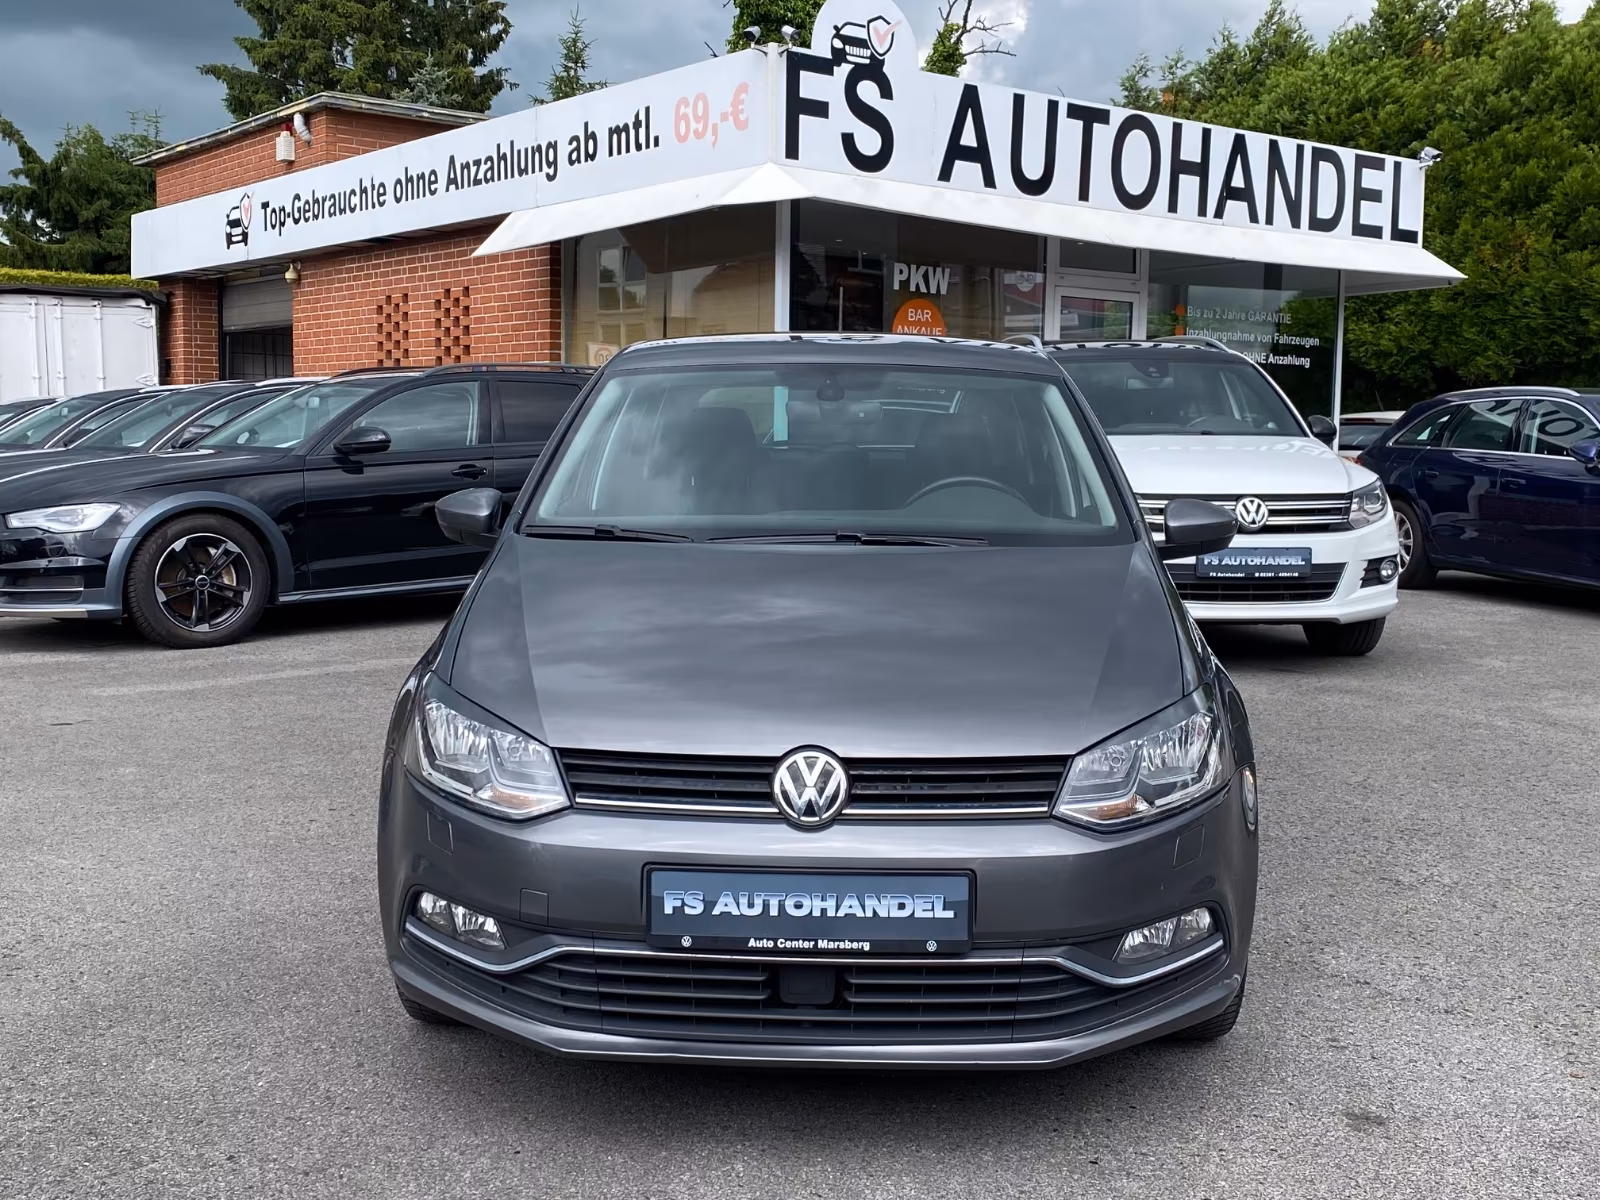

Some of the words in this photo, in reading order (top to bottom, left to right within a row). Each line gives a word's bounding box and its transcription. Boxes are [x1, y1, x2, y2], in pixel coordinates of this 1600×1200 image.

[785, 49, 895, 174] FS
[936, 82, 1420, 246] AUTOHANDEL
[261, 176, 388, 237] Top-Gebrauchte
[393, 165, 440, 205] ohne
[444, 139, 558, 194] Anzahlung
[567, 120, 598, 168] ab
[607, 104, 660, 158] mtl.
[674, 80, 749, 149] 69,-€
[893, 262, 951, 295] PKW
[908, 308, 932, 322] BAR
[1187, 305, 1201, 318] Bis
[1203, 309, 1213, 318] zu
[1215, 308, 1221, 319] 2
[1222, 310, 1246, 321] Jahre
[1247, 311, 1292, 324] GARANTIE
[1257, 333, 1272, 343] von
[1273, 333, 1320, 348] Fahrzeugen
[1268, 353, 1310, 368] Anzahlung
[1204, 556, 1219, 565] FS
[1221, 556, 1305, 565] AUTOHANDEL
[663, 890, 705, 916] FS
[711, 891, 955, 919] AUTOHANDEL
[747, 937, 774, 948] Auto
[776, 938, 815, 949] Center
[817, 939, 870, 951] Marsberg
